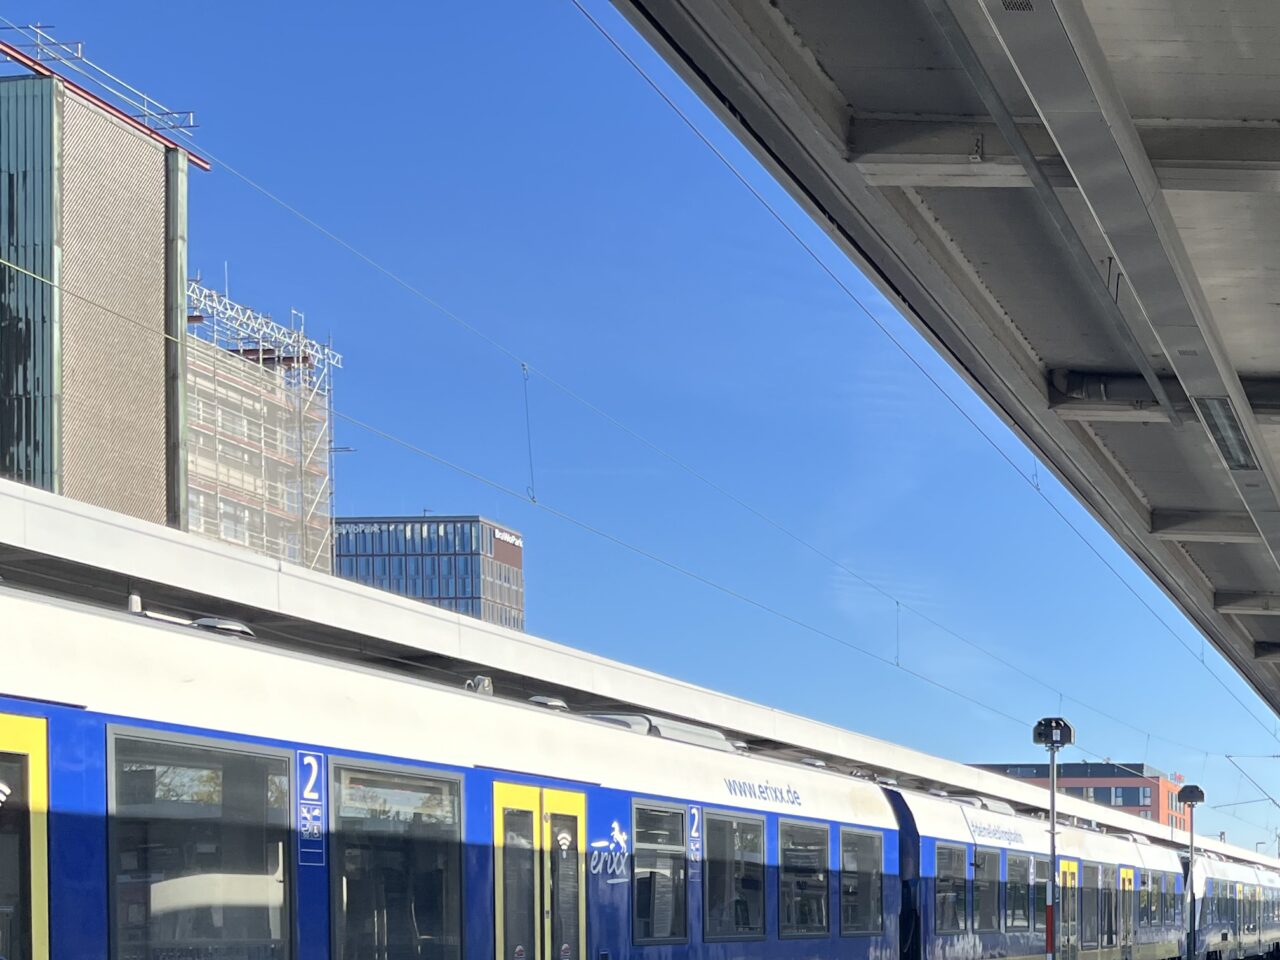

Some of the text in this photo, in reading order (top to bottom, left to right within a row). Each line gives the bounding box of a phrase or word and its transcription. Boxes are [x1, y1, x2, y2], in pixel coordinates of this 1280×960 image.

[303, 756, 319, 799] 2
[724, 777, 802, 806] www.erixx.de
[691, 808, 699, 838] 2
[590, 849, 628, 876] erixx
